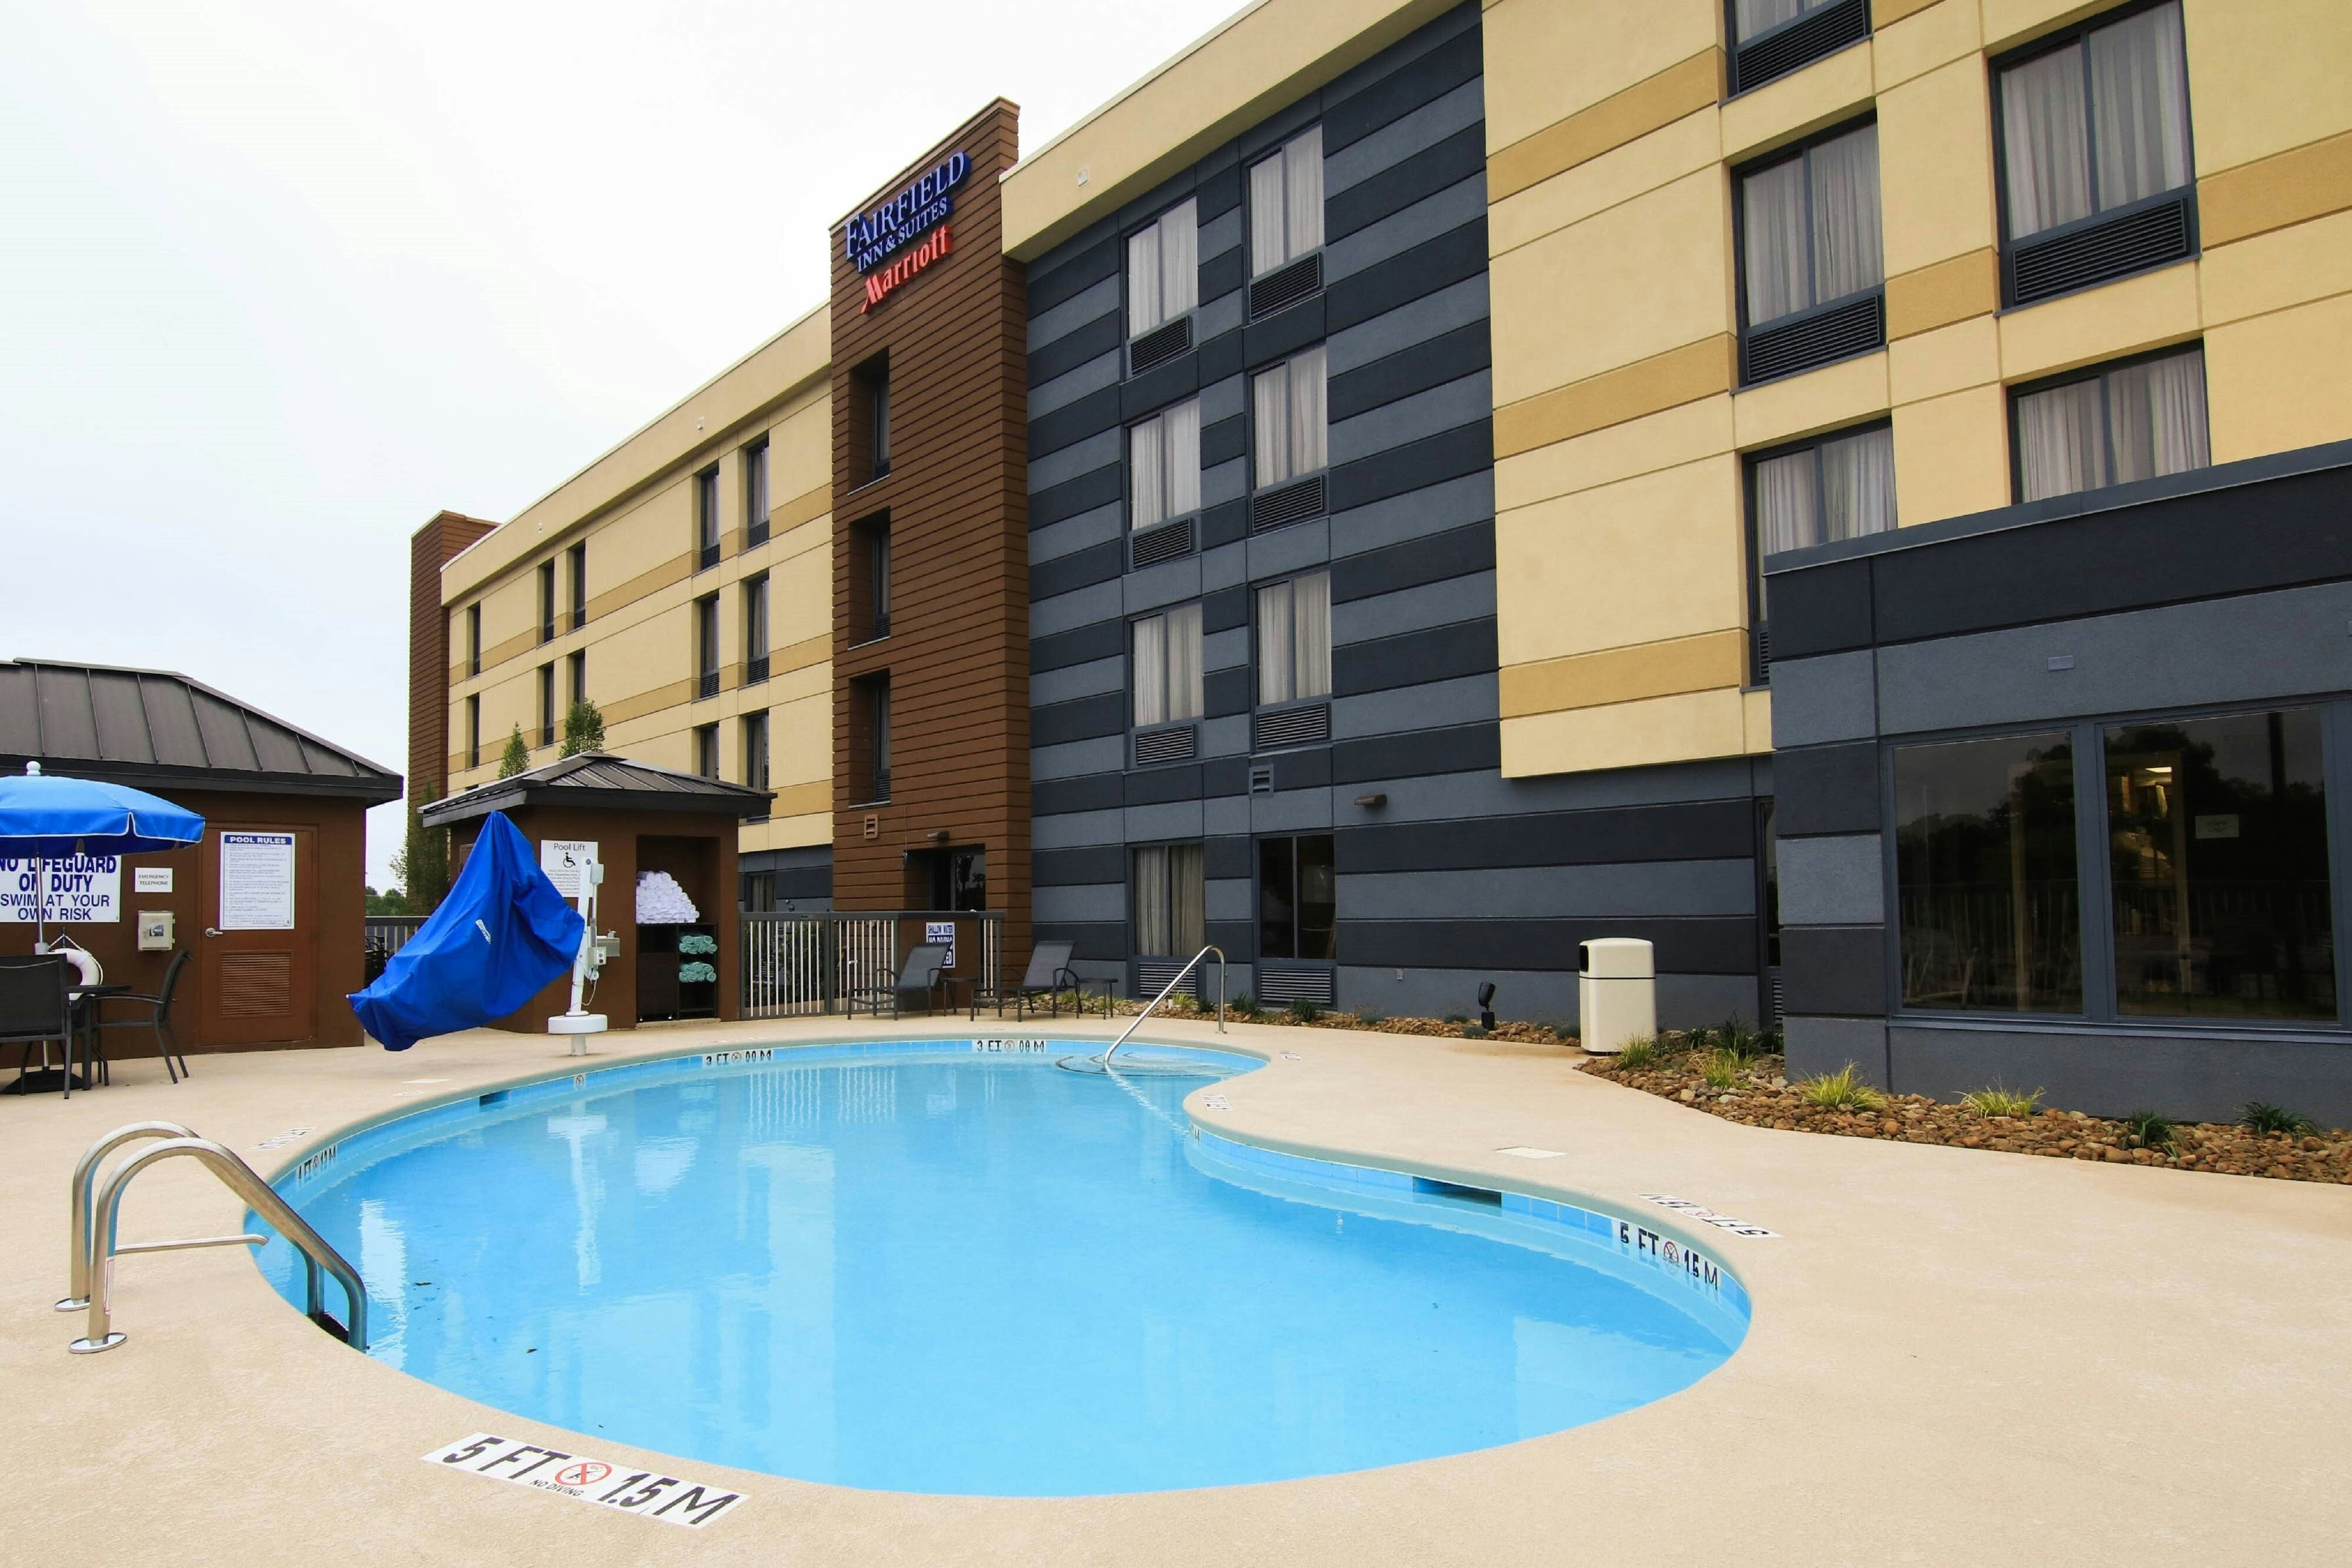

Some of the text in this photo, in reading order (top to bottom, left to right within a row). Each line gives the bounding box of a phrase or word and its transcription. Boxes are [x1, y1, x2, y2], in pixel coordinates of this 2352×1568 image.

[845, 152, 967, 260] FAIRFIELD
[857, 196, 948, 273] INN & SUITES
[860, 225, 949, 313] Marriott
[28, 855, 116, 873] LFEGUARD
[51, 874, 93, 892] DUTY
[46, 894, 64, 906] AT
[71, 895, 110, 907] YOUR
[60, 908, 92, 920] RISK
[1621, 1222, 1629, 1243] 5
[1638, 1228, 1659, 1255] FT
[1705, 1261, 1718, 1290] M
[443, 1436, 740, 1525] 5 FT 1.5 M
[546, 1483, 584, 1497] DIVING
